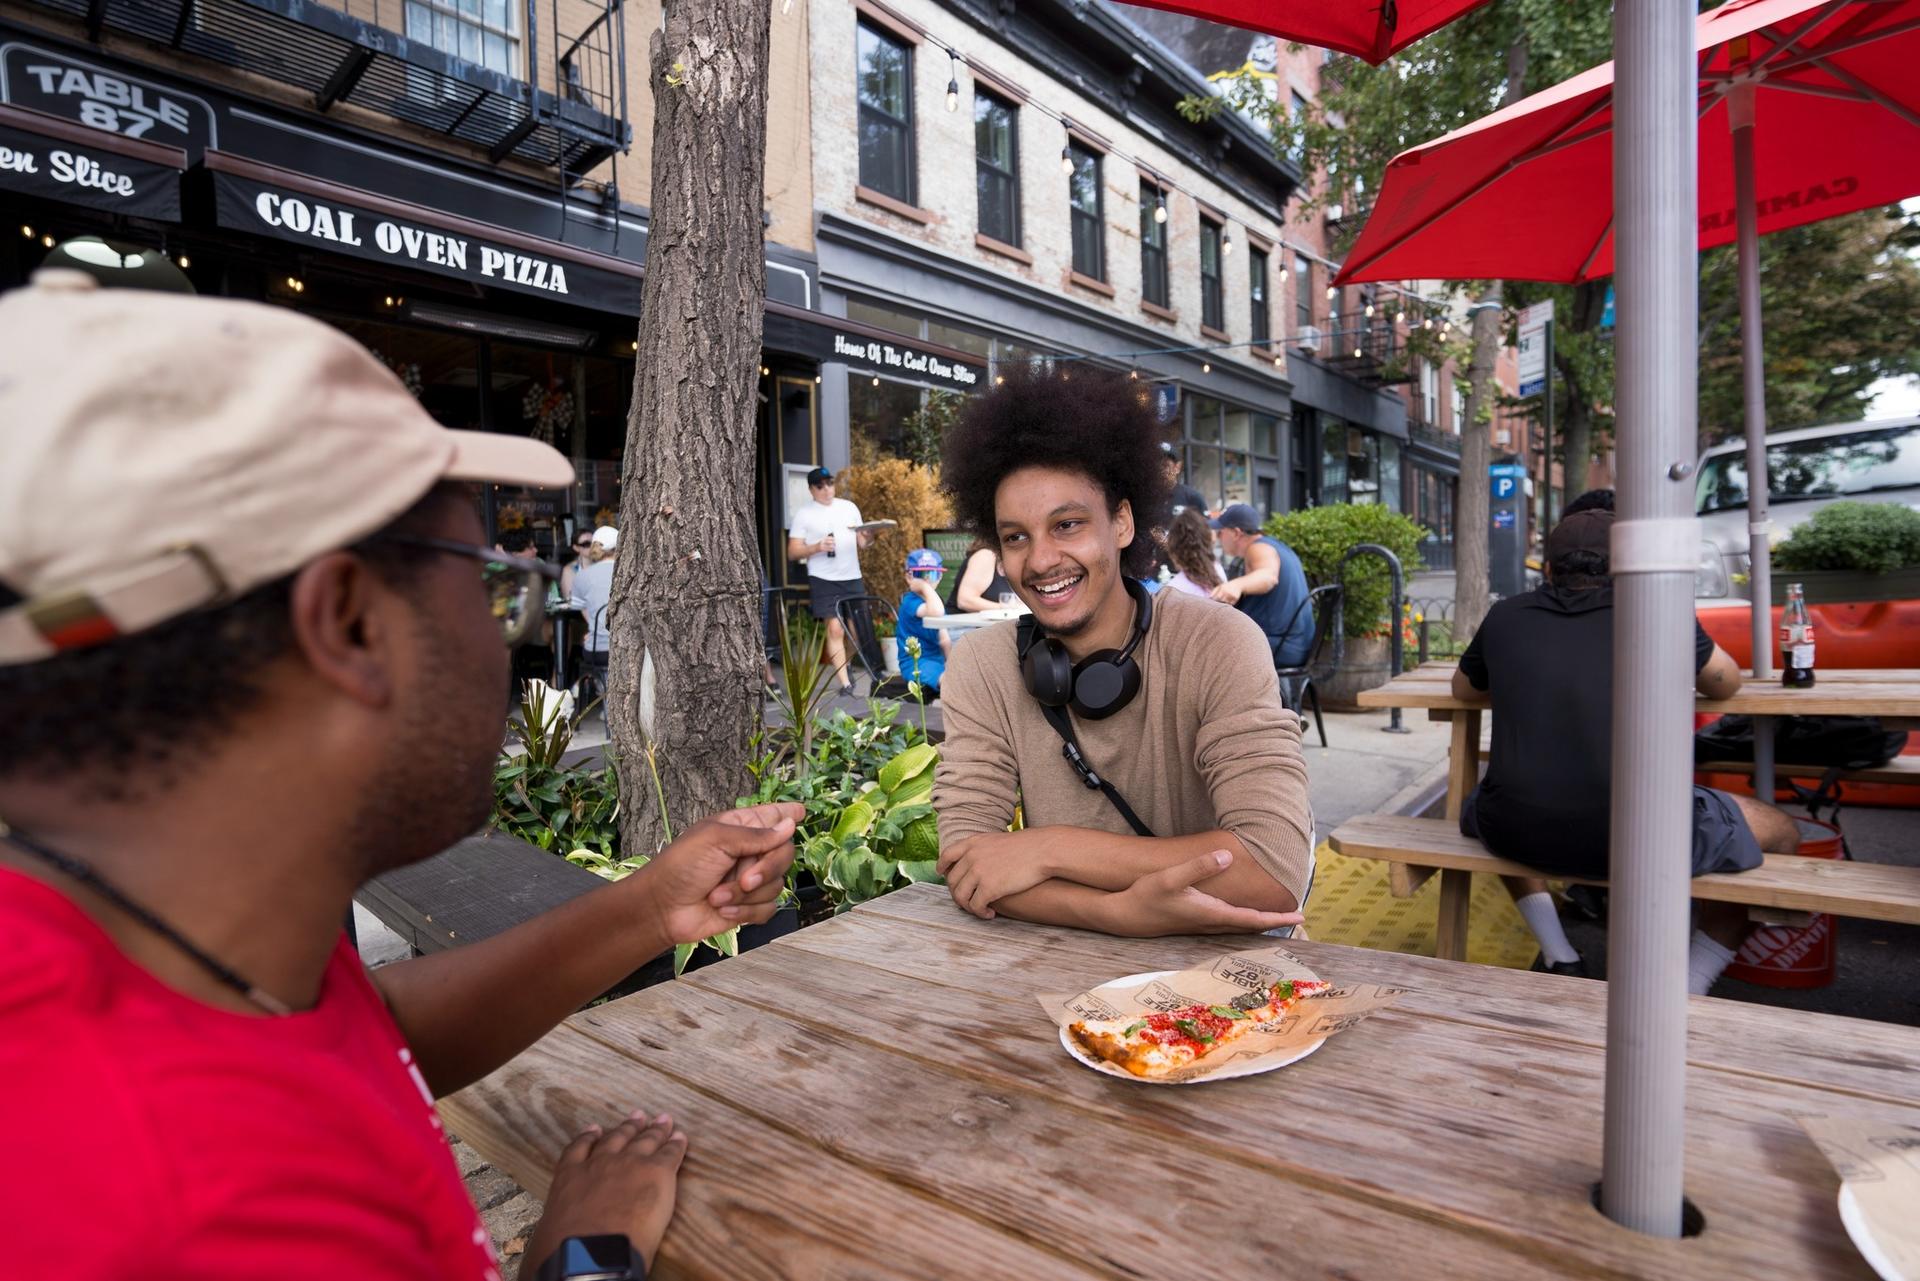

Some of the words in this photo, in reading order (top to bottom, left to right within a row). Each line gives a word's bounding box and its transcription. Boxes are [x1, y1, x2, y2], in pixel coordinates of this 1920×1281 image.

[26, 65, 189, 134] TABLE
[80, 100, 154, 138] 87
[50, 151, 135, 196] Slice
[256, 192, 361, 247] COAL
[375, 221, 468, 270] OVEN
[480, 246, 569, 294] PIZZA
[834, 334, 865, 359] Home
[867, 343, 882, 364] Of
[884, 345, 902, 366] The
[1499, 478, 1513, 497] P
[1235, 969, 1259, 981] 87
